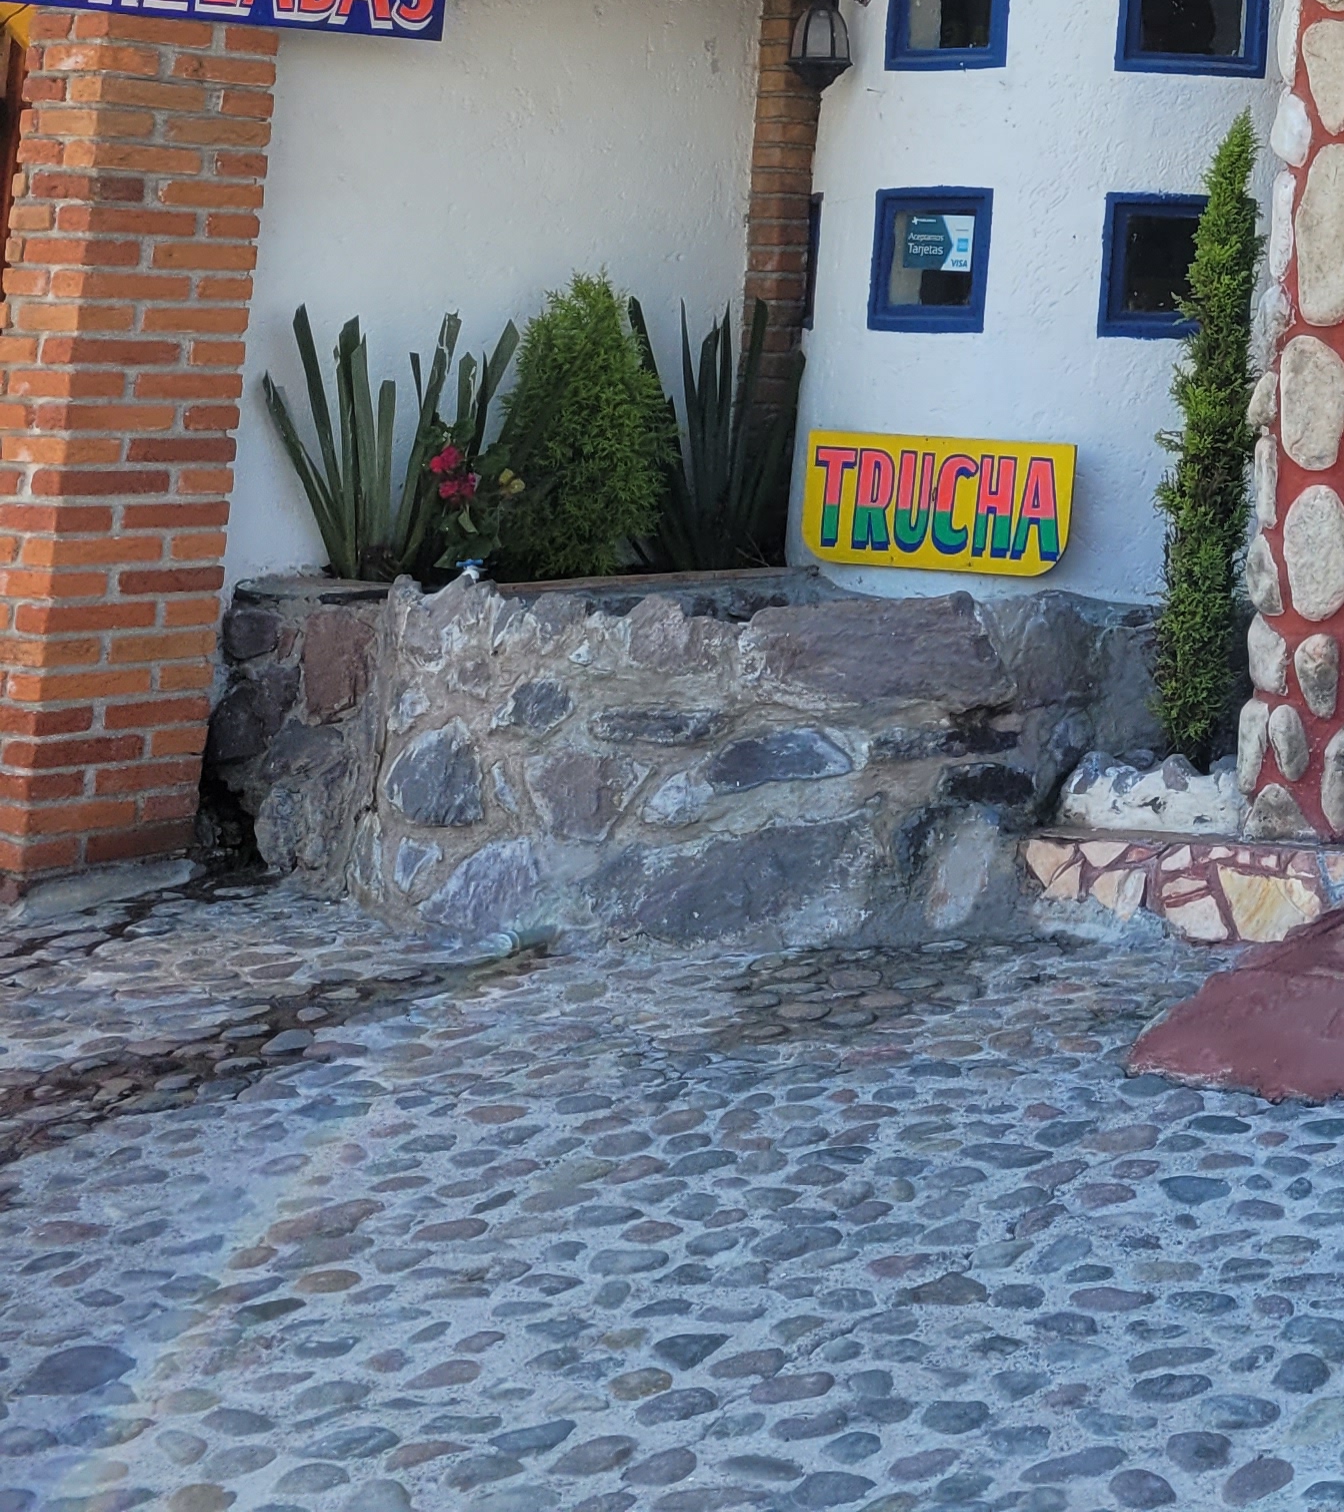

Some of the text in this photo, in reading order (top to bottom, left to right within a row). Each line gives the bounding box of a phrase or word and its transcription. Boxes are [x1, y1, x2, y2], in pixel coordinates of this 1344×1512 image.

[908, 242, 944, 257] Tarjetas
[951, 259, 968, 268] VISA
[815, 445, 1060, 562] TRUCHA
